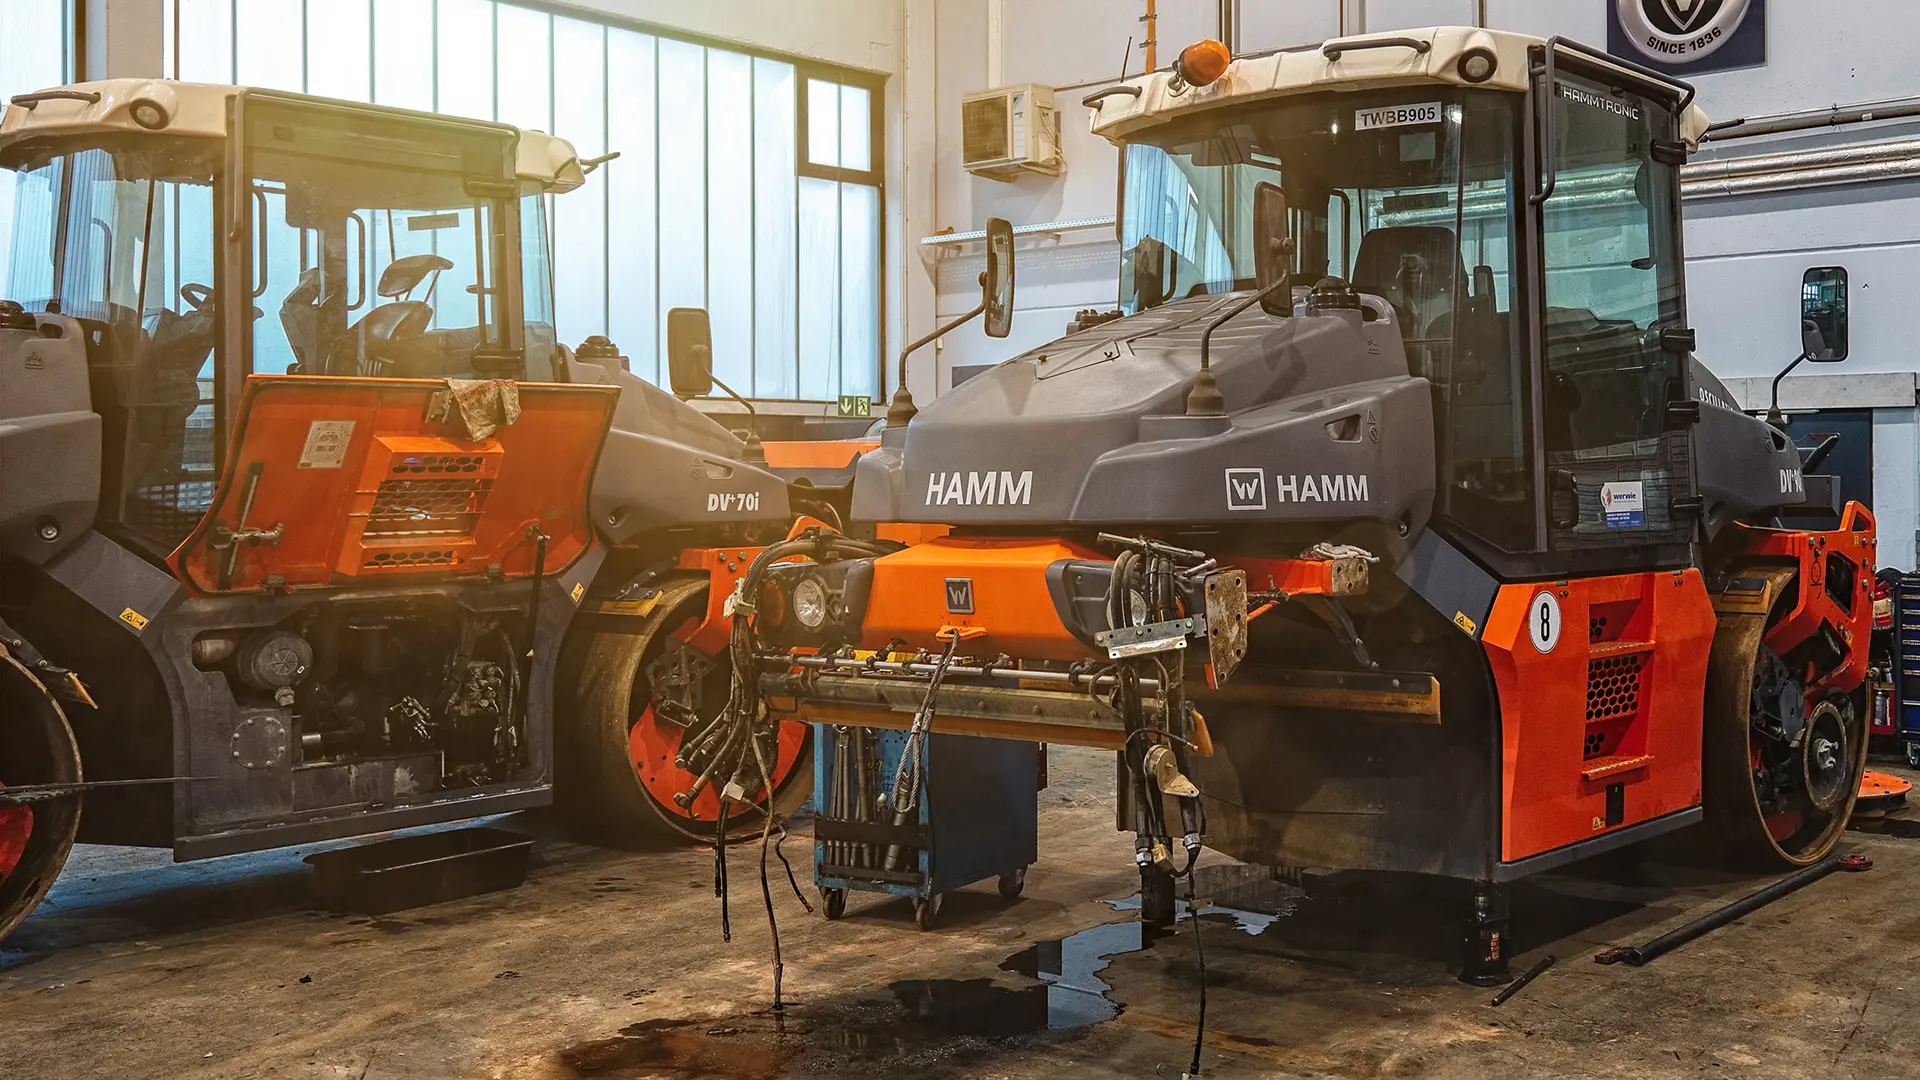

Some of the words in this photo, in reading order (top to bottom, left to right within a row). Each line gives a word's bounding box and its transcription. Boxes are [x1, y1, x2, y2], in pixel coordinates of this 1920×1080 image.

[1646, 35, 1686, 54] SINCE
[1689, 26, 1722, 51] 1836
[1361, 106, 1436, 127] TWBB905
[1563, 86, 1639, 120] HAMMTRONIC
[707, 491, 760, 512] DV+70i
[925, 470, 1034, 506] HAMM
[1276, 474, 1370, 503] HAMM
[1540, 601, 1551, 642] 8
